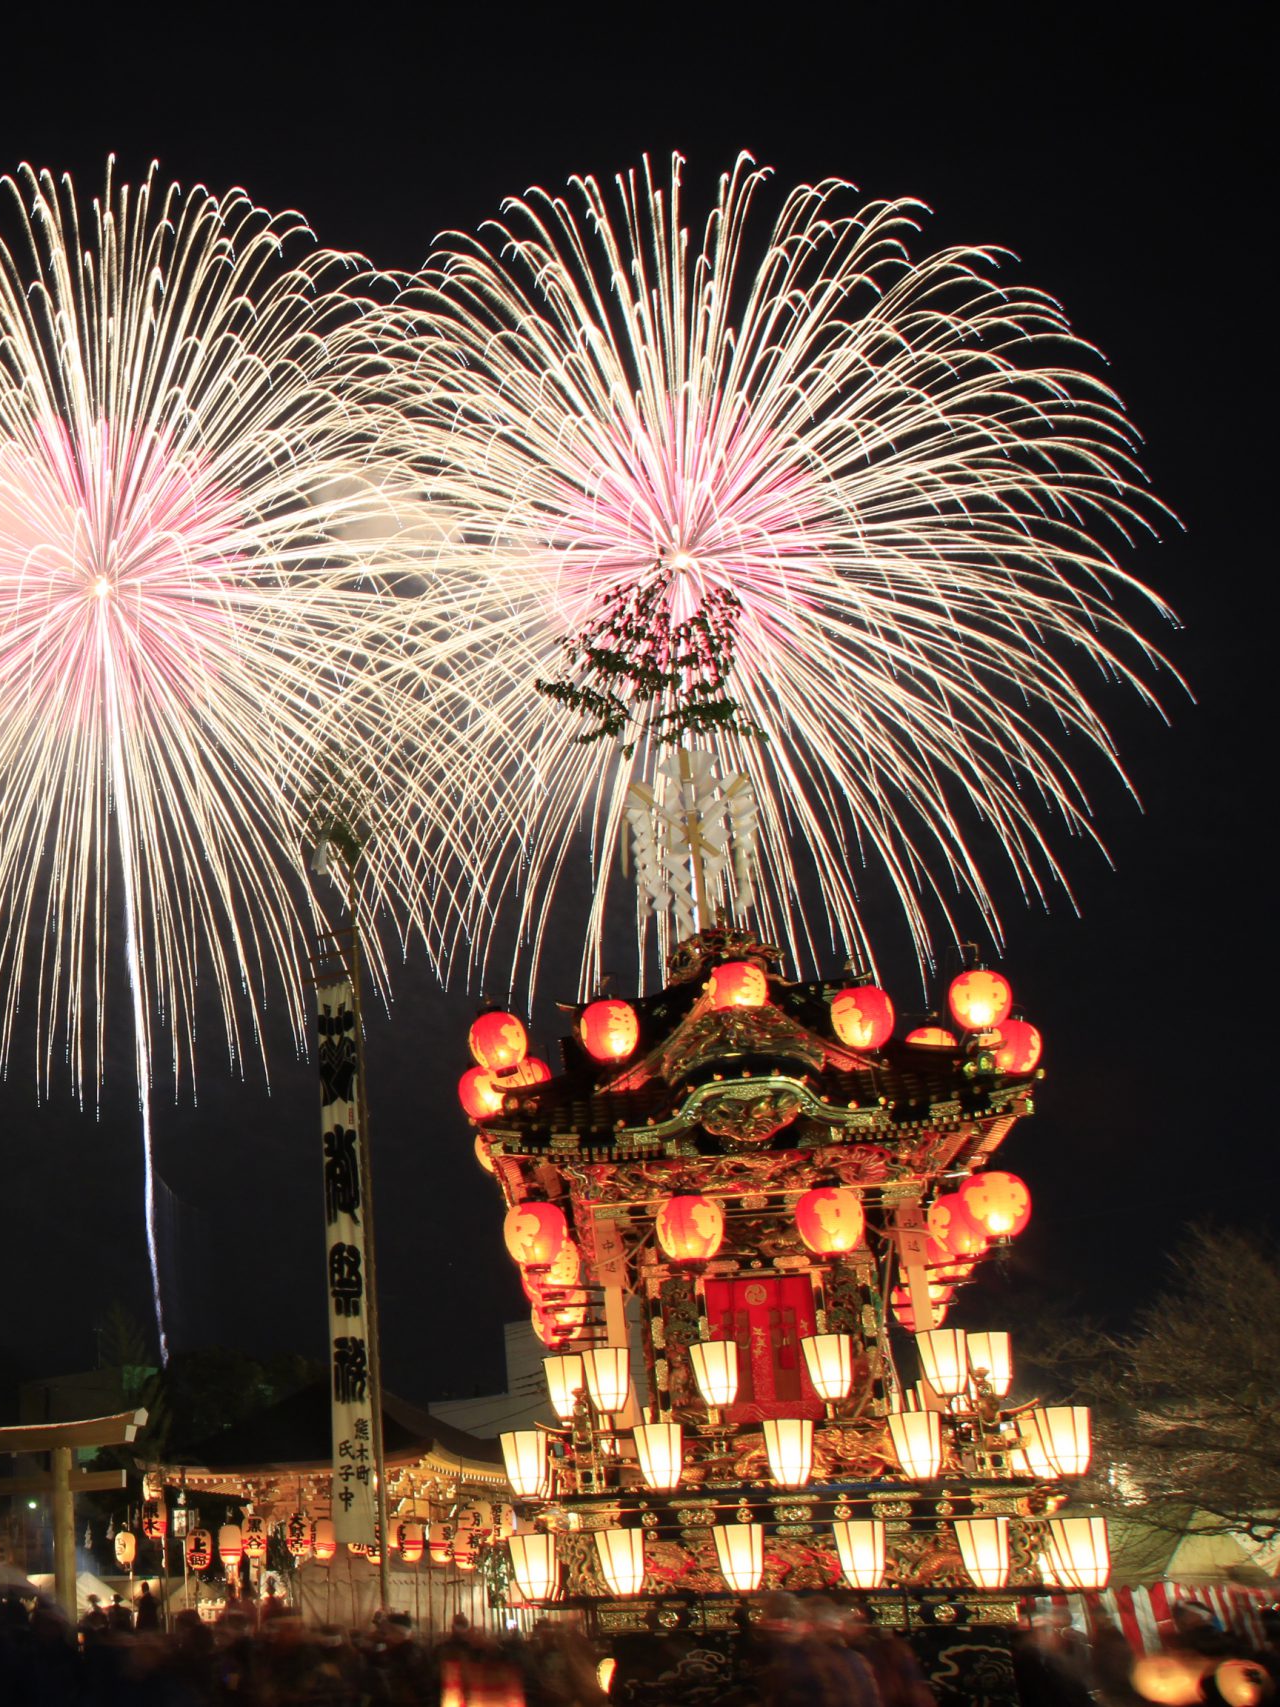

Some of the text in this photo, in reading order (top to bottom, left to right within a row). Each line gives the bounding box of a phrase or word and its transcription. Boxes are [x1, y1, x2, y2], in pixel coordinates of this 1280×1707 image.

[353, 1418, 371, 1487] 熊木町
[246, 1518, 263, 1549] 黒谷
